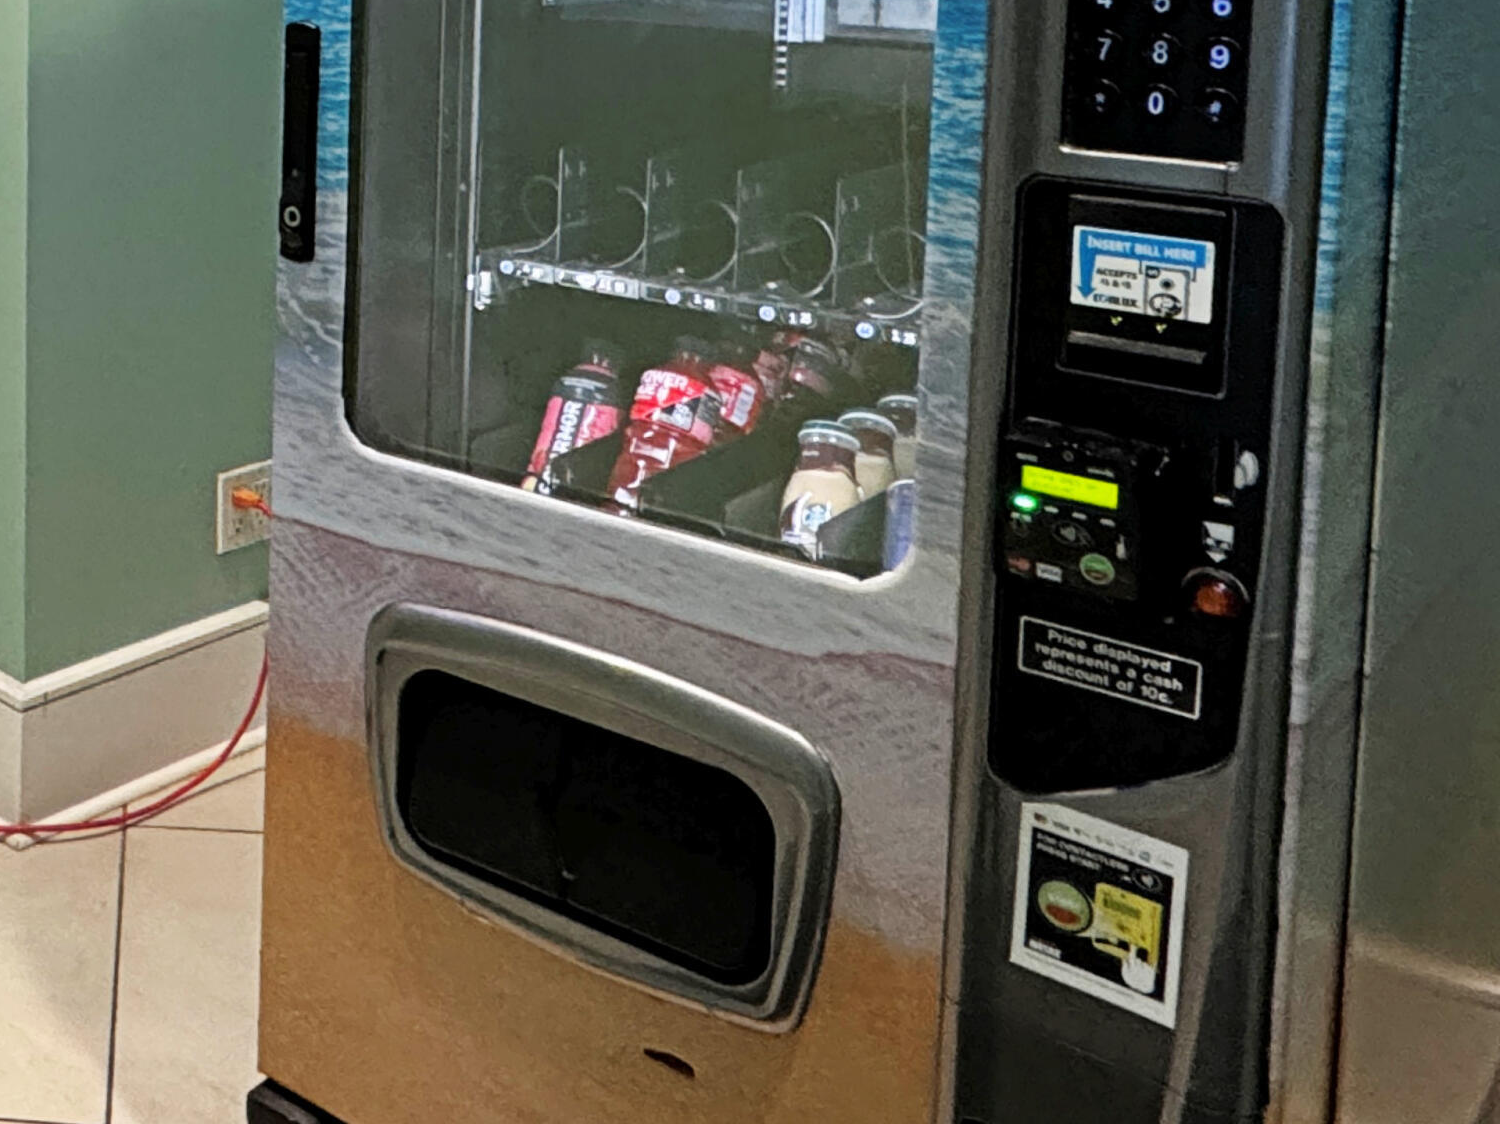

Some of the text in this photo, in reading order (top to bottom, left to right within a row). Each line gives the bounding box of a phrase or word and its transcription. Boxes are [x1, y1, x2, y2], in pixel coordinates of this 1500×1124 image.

[1098, 37, 1230, 69] 7 8 9
[1147, 91, 1164, 115] 0
[1035, 642, 1184, 692] represents a cash
[1048, 629, 1172, 674] Price displayed
[1042, 658, 1110, 687] discount
[1116, 677, 1134, 695] of
